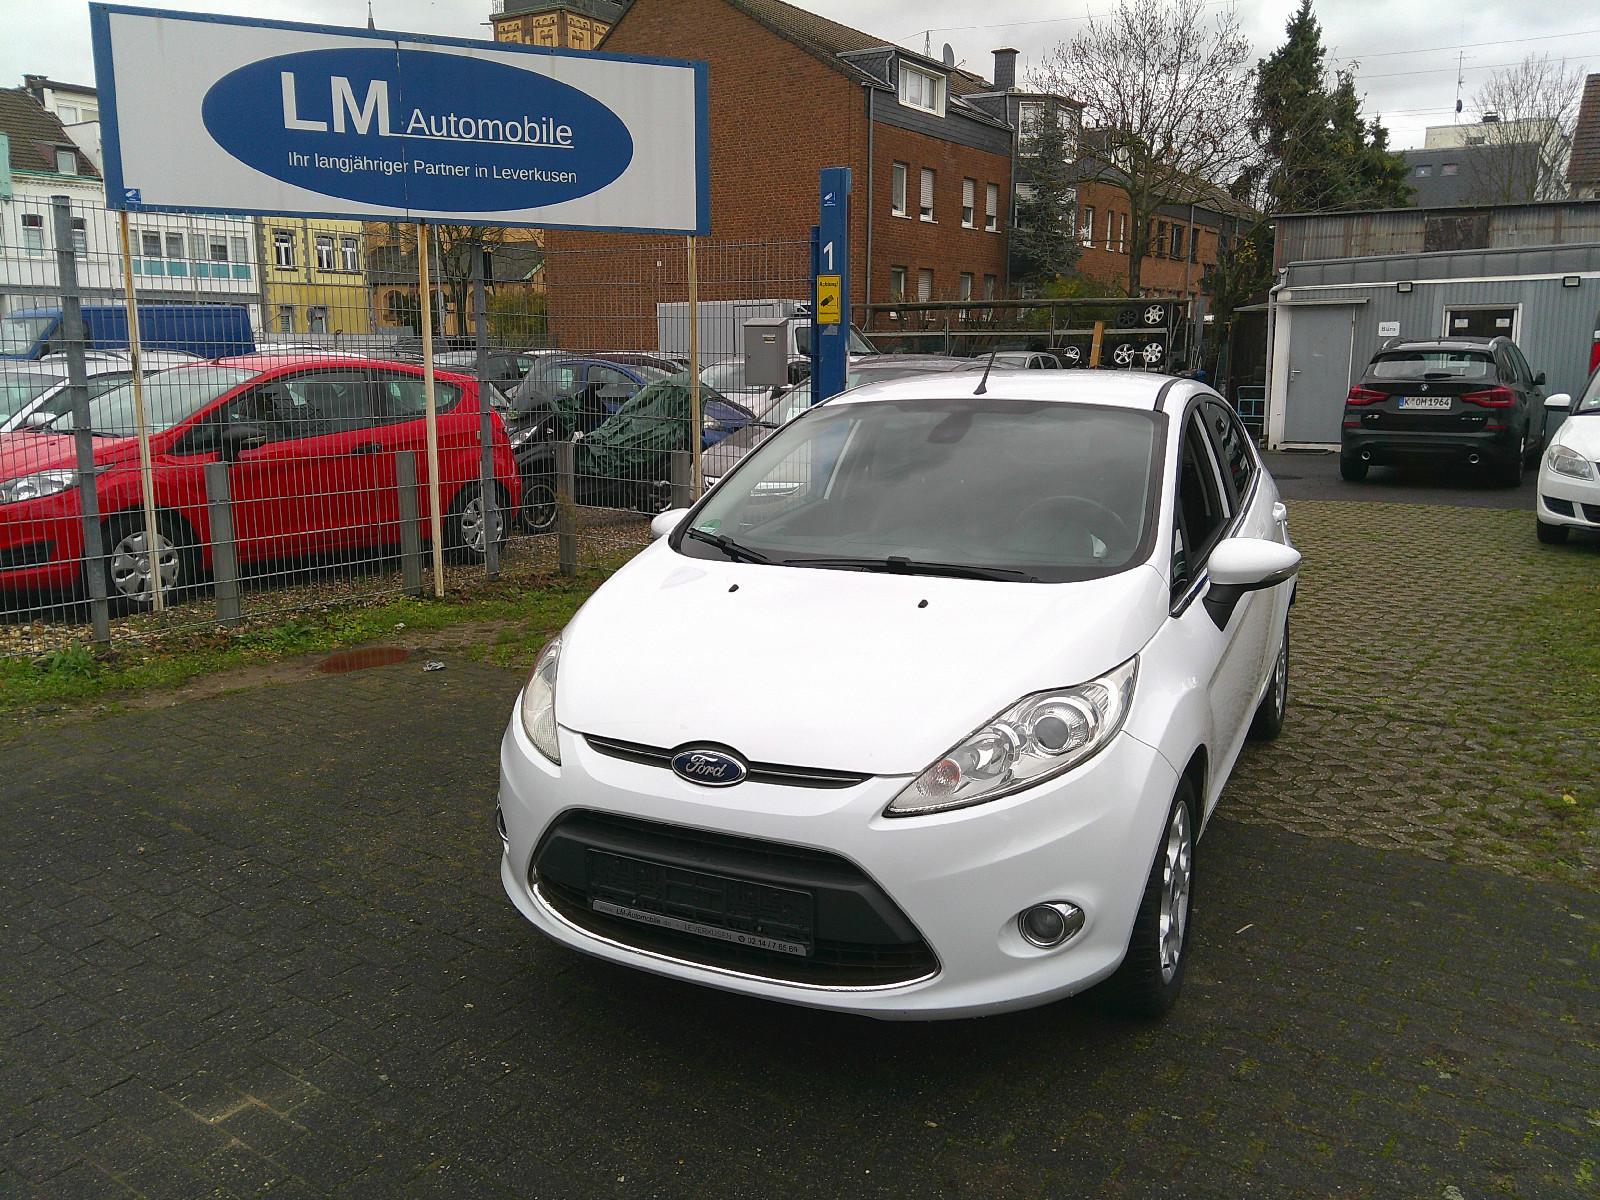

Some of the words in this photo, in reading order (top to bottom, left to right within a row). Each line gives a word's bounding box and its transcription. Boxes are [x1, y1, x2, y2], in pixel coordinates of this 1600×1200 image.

[281, 71, 389, 136] LM
[406, 108, 573, 145] Automobile
[288, 151, 310, 167] Ihr
[315, 152, 409, 176] langjähriger
[414, 160, 470, 177] Partner
[475, 163, 488, 178] in
[493, 165, 577, 184] Leverkusen
[823, 241, 833, 271] 1
[686, 754, 728, 778] Ford
